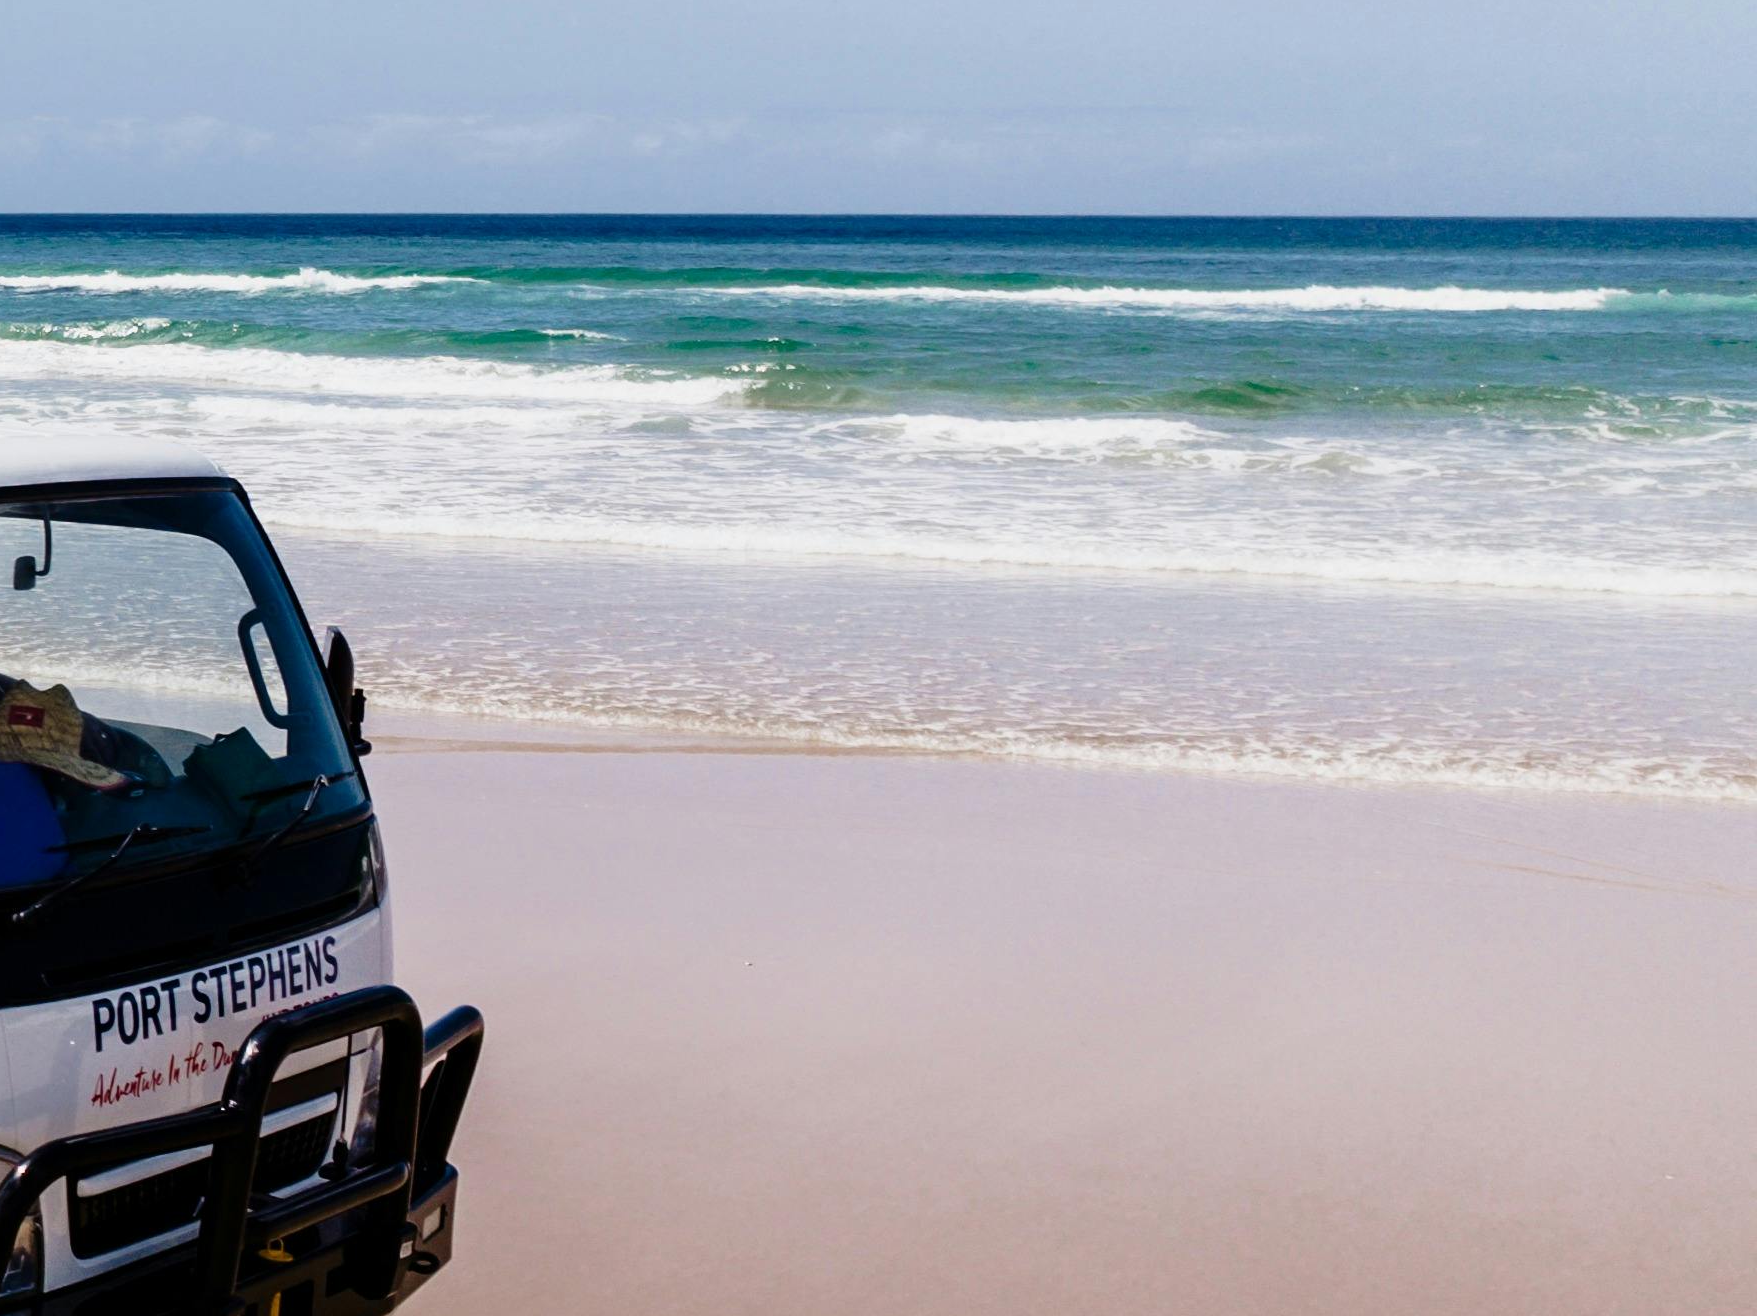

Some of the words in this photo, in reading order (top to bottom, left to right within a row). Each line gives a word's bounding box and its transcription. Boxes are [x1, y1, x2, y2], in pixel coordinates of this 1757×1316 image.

[91, 978, 181, 1053] PORT
[191, 935, 339, 1024] STEPHENS
[90, 1066, 165, 1108] Adventure
[168, 1054, 181, 1087] In
[184, 1041, 207, 1079] the
